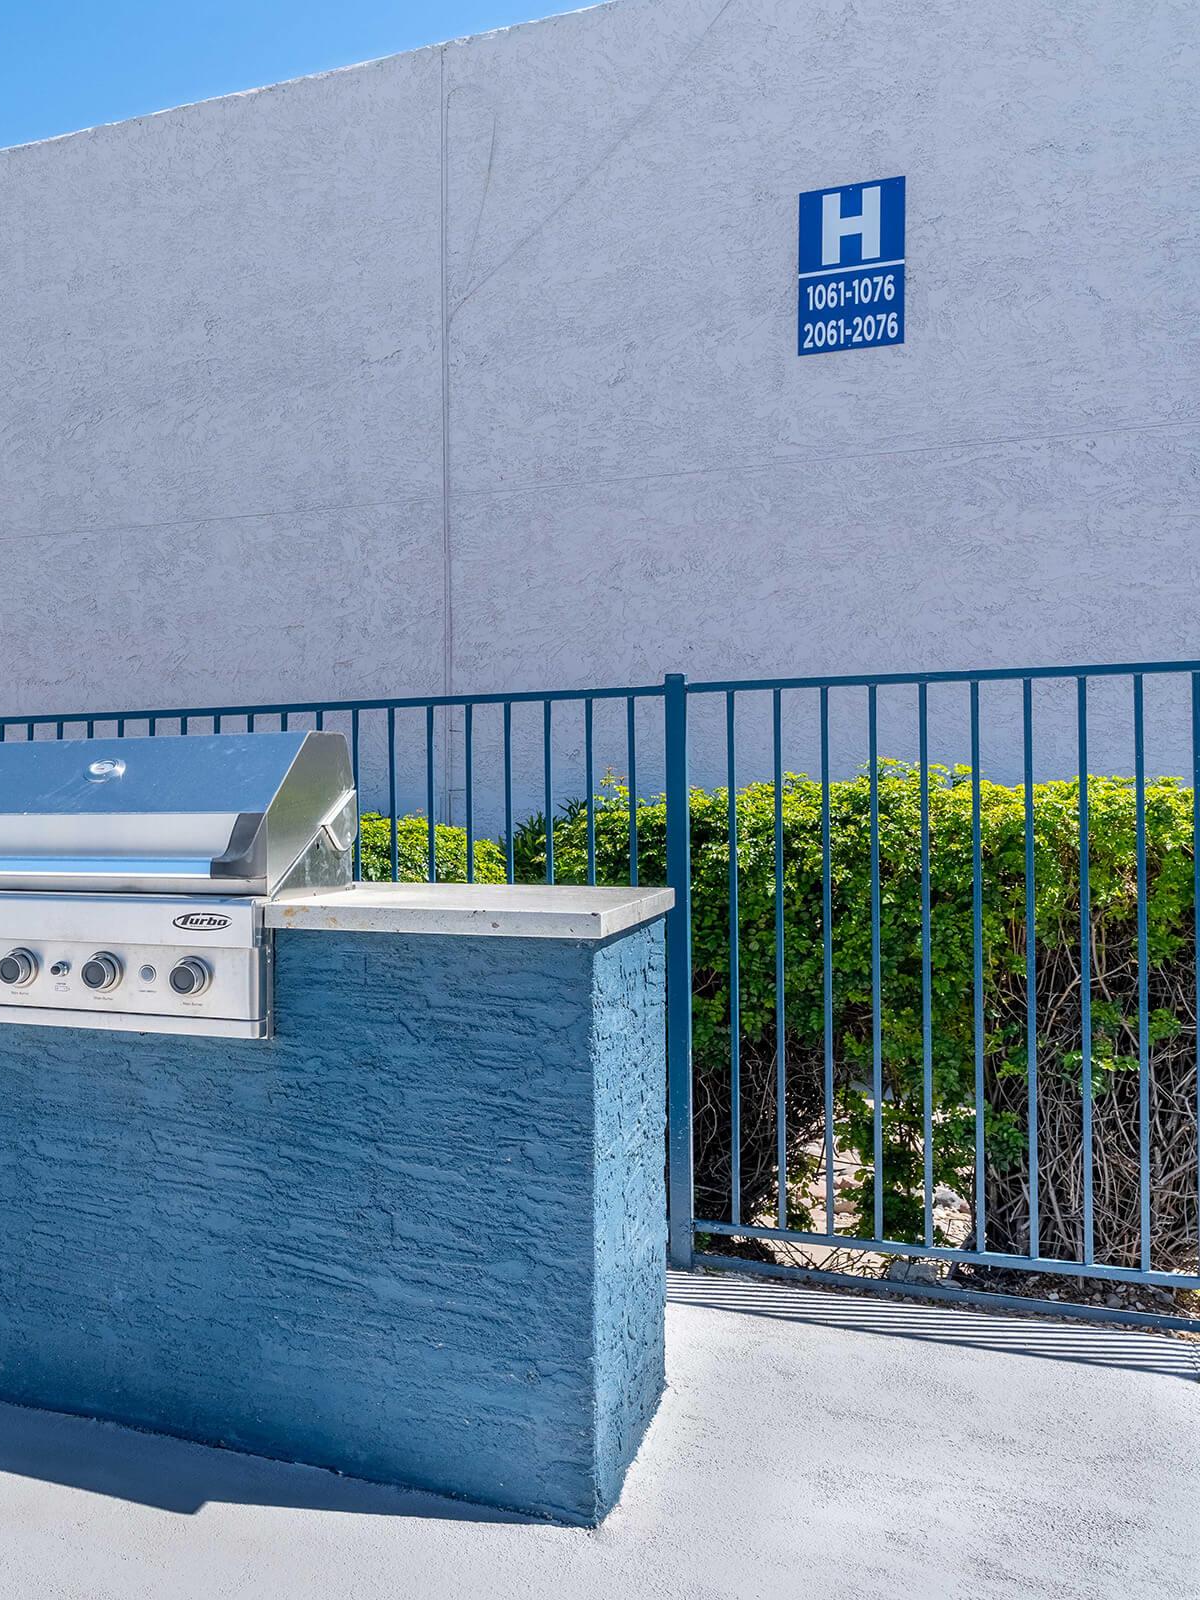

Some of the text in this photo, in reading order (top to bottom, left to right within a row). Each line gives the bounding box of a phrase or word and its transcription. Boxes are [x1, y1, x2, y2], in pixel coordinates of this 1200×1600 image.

[822, 186, 881, 266] H
[807, 274, 895, 311] 1061-1076
[803, 312, 898, 349] 2061-2076
[176, 913, 229, 926] Turbo
